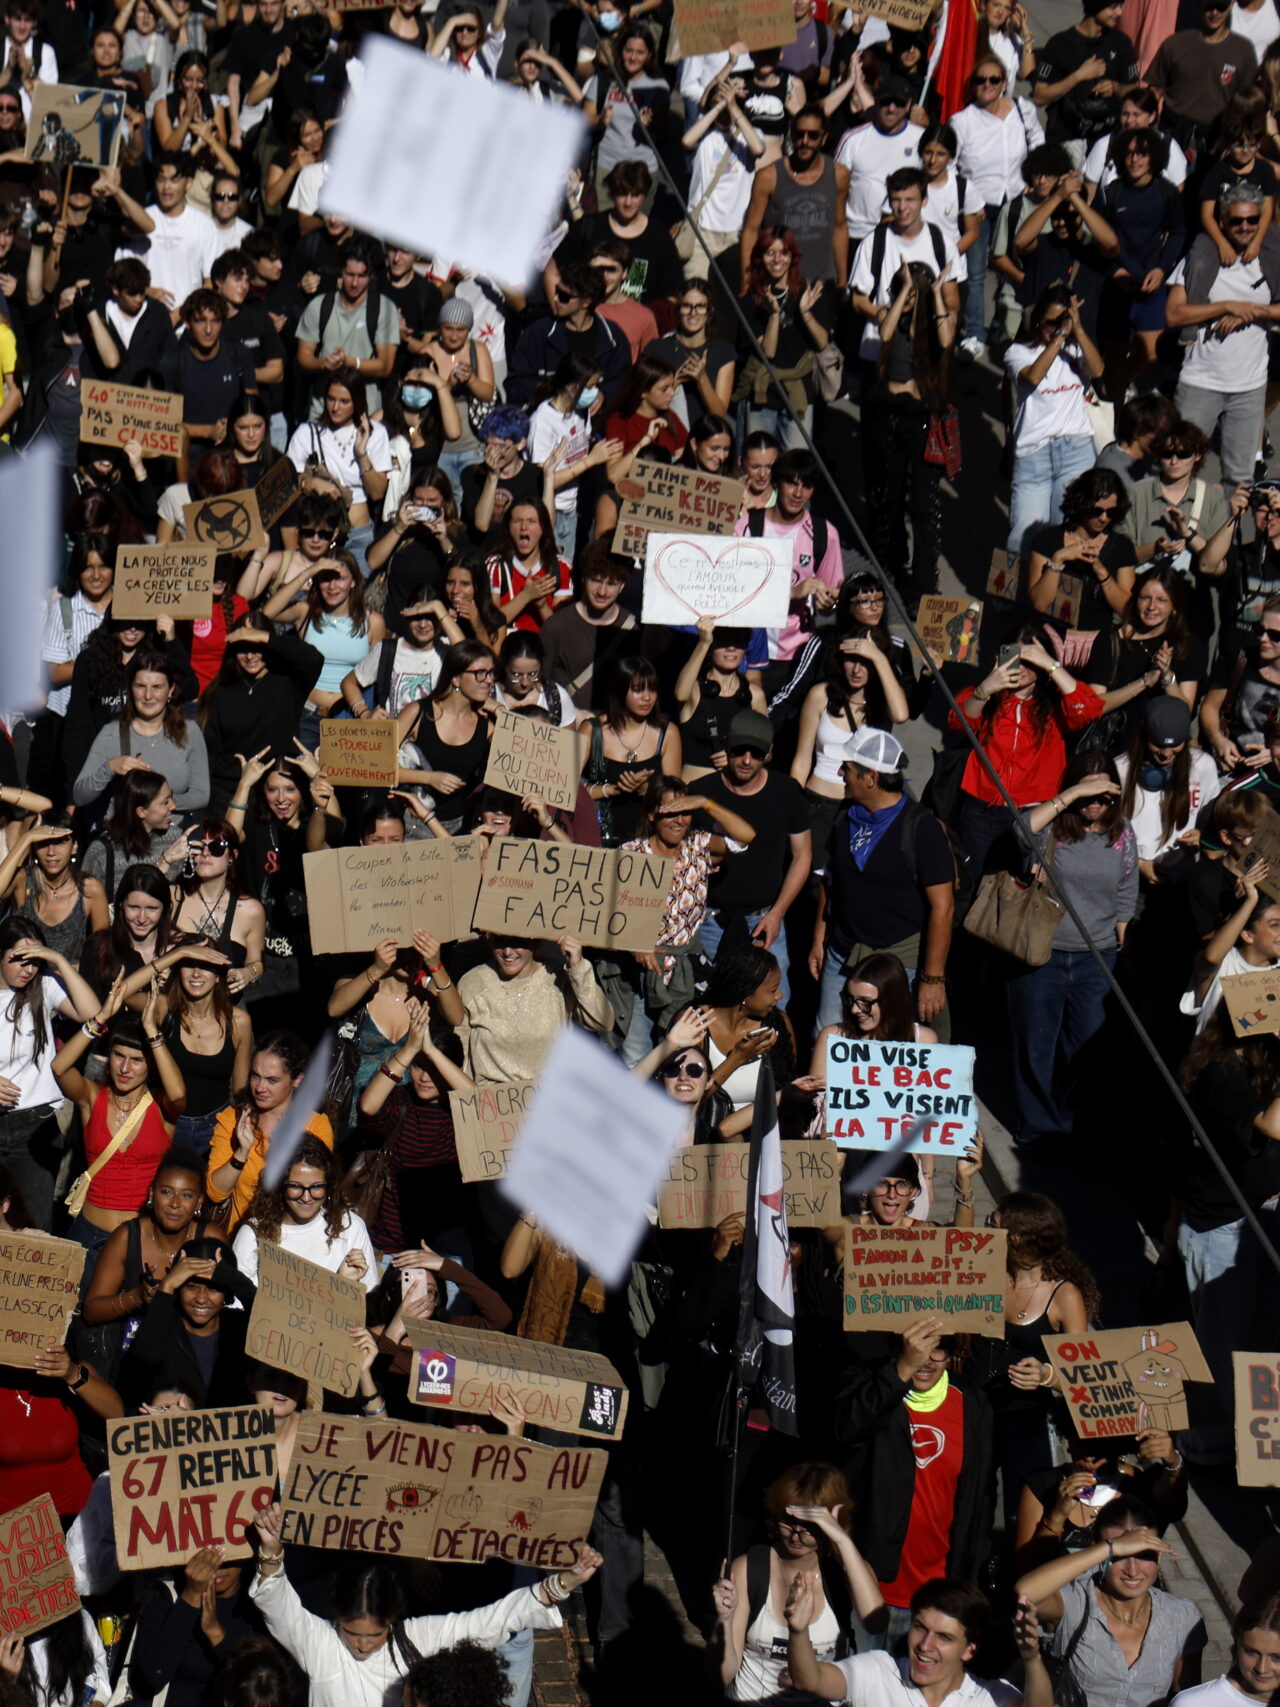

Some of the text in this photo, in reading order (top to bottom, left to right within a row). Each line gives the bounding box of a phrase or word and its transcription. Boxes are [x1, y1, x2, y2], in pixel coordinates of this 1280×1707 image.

[87, 406, 152, 430] PAS D'UNE
[92, 426, 107, 438] DE
[635, 463, 722, 496] J'AIME PAS
[647, 481, 736, 524] LES KEUFS
[627, 501, 725, 535] J'FAIS PAS DE
[122, 553, 208, 569] LA POLICE NOUS
[125, 579, 210, 593] ÇA LES
[144, 591, 183, 605] YEUX
[499, 711, 561, 744] IF WE
[338, 737, 384, 752] POUBELLE
[510, 734, 561, 767] BURN
[493, 749, 568, 789] YOU BURN
[504, 774, 545, 795] WITH
[497, 841, 666, 889] FASHION
[553, 878, 605, 907] PAS
[504, 896, 627, 936] FACHO
[829, 1041, 932, 1069] ON VISE
[852, 1065, 953, 1089] LE BAC
[460, 1085, 537, 1122] MACRO
[829, 1086, 972, 1117] ILS VISENT
[833, 1113, 964, 1145] LA TÊTE
[795, 1150, 835, 1180] PAS
[851, 1226, 938, 1244] PAS BESOIN DE
[851, 1247, 925, 1266] FANON A
[12, 1272, 39, 1289] UNE
[36, 1275, 80, 1294] PRISON
[262, 1244, 361, 1301] FINANCEZ NOS
[877, 1269, 987, 1287] VIOLENCE EST
[47, 1302, 65, 1321] ÇA
[288, 1311, 318, 1336] DES
[324, 1307, 362, 1333] QUE
[4, 1328, 46, 1349] PORTE
[1057, 1340, 1101, 1363] ON
[249, 1317, 358, 1395] GENOCIDES
[475, 1359, 561, 1388] POUR LES
[1059, 1360, 1119, 1385] VEUT
[1089, 1381, 1136, 1404] FINIR
[1079, 1401, 1139, 1418] COMME
[111, 1407, 277, 1457] GENERATION
[1080, 1416, 1137, 1438] LARRY
[300, 1422, 592, 1490] JE VIENS PAS AU
[122, 1443, 277, 1500] 67 REFAIT
[288, 1464, 369, 1508] LYCÉE
[127, 1493, 225, 1557] MAI
[280, 1510, 584, 1569] EN PIECÈS DÉTACHÉES
